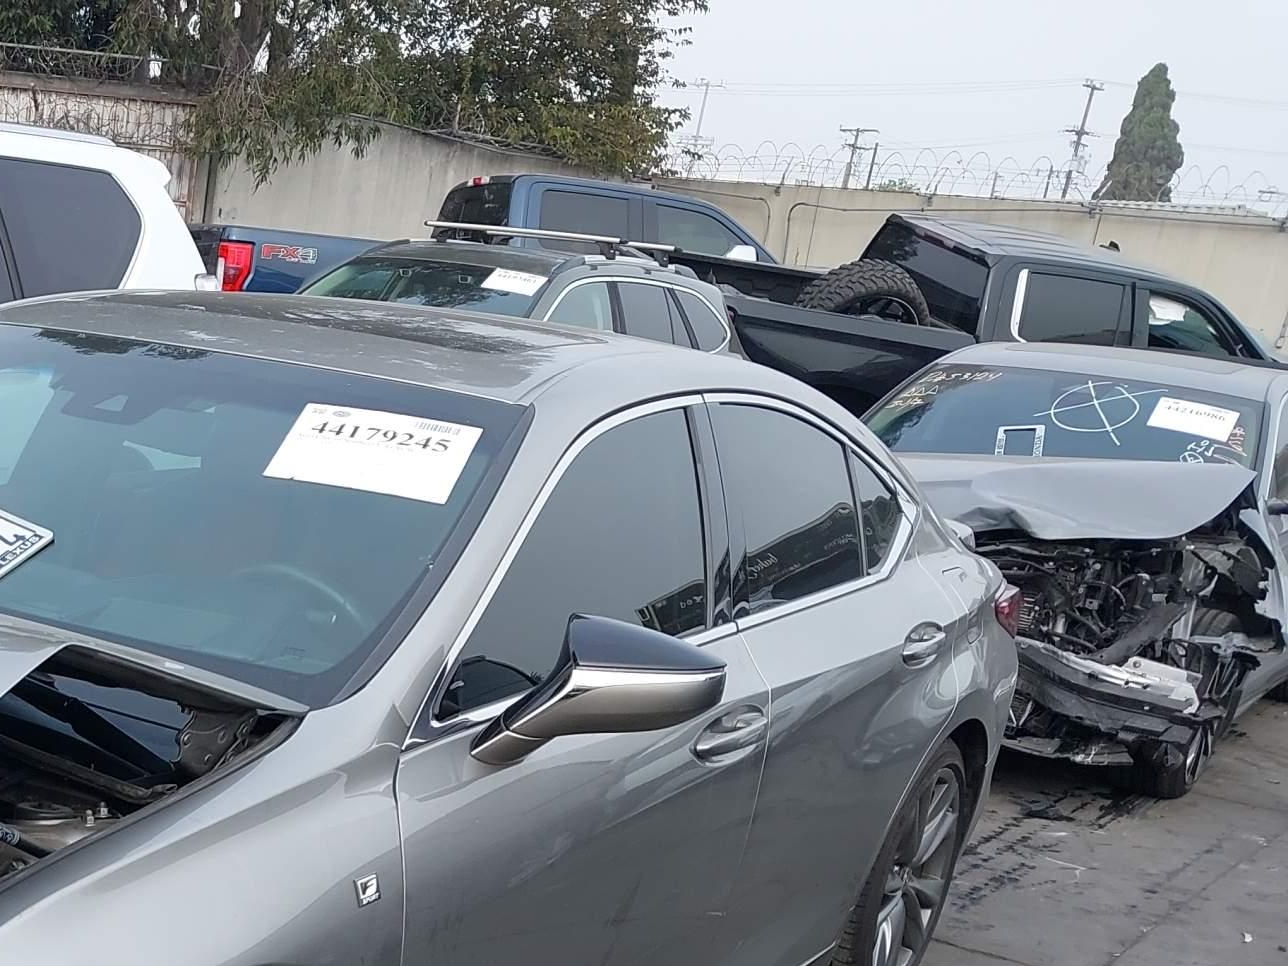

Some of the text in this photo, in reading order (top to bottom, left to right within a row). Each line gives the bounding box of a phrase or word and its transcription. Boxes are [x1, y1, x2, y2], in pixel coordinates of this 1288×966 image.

[261, 244, 318, 263] FX4
[312, 421, 452, 453] 44179245
[0, 535, 41, 567] LEXUS
